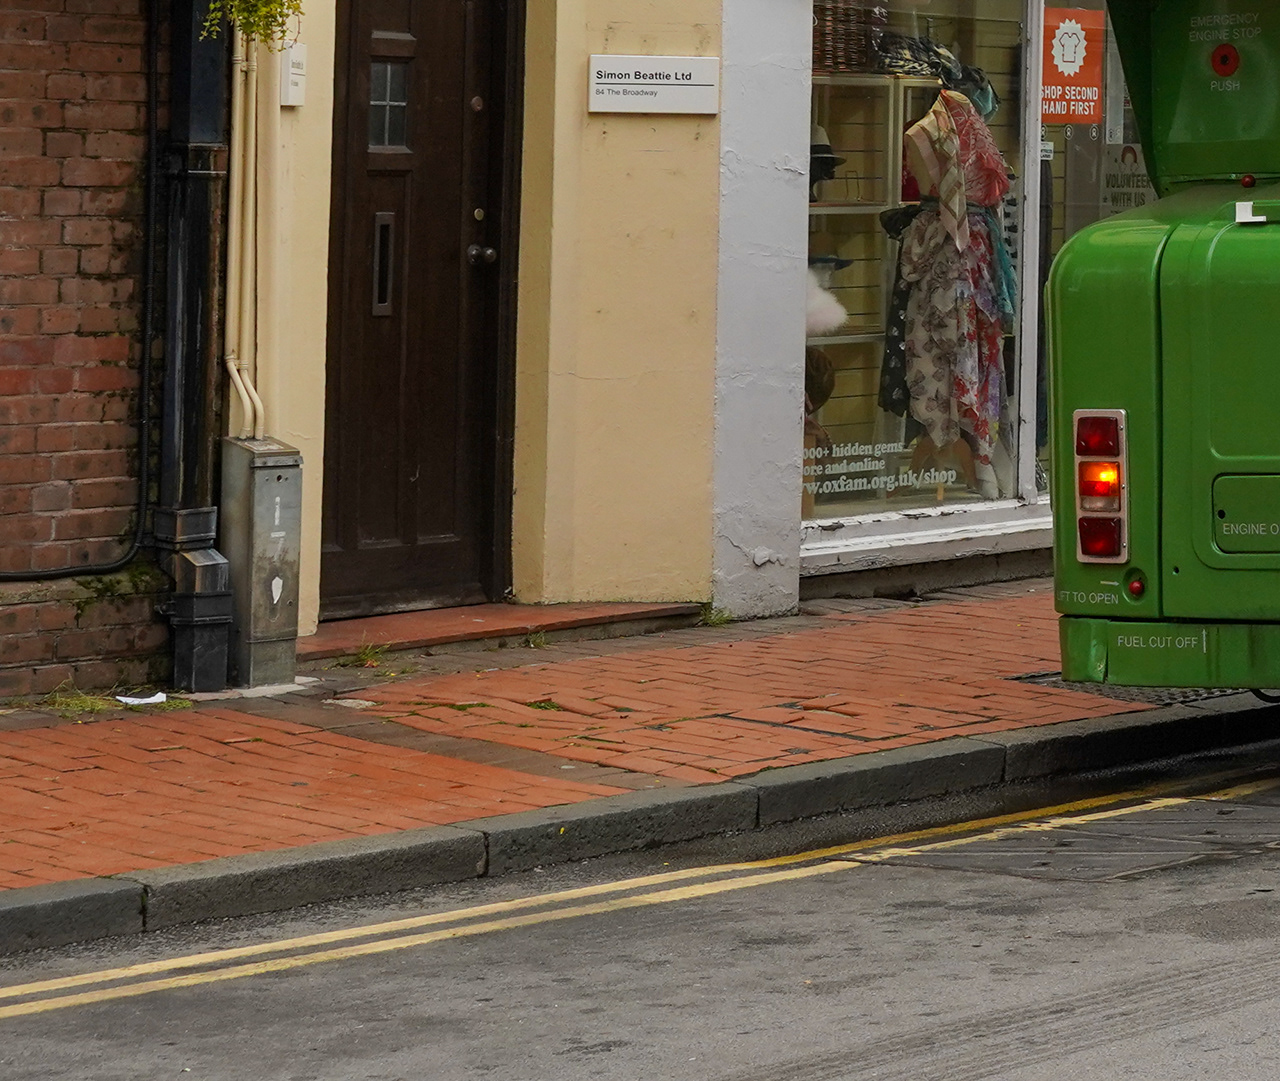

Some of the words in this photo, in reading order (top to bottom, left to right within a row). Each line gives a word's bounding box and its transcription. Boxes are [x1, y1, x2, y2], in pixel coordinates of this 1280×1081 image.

[1190, 13, 1259, 27] EMERGENCY
[1189, 29, 1230, 42] ENGINE
[1232, 27, 1262, 39] STOP
[596, 70, 630, 80] Simon
[634, 71, 671, 80] Beattie
[674, 72, 692, 80] Ltd
[1041, 85, 1062, 99] SHOP
[1065, 86, 1098, 100] SECOND
[1210, 80, 1240, 91] PUSH
[622, 89, 658, 98] Broadway
[1043, 101, 1067, 114] HAND
[1070, 102, 1095, 115] FIRST
[1111, 192, 1132, 207] WITH
[1134, 192, 1146, 207] US
[832, 442, 873, 457] hidden
[874, 442, 904, 457] gems
[825, 458, 849, 473] and
[849, 457, 886, 472] online
[1223, 523, 1267, 535] ENGINE
[1072, 592, 1086, 603] TO
[1089, 593, 1119, 604] OPEN
[1117, 636, 1146, 648] FUEL
[1149, 636, 1172, 648] CUT
[1175, 637, 1198, 649] OFF
